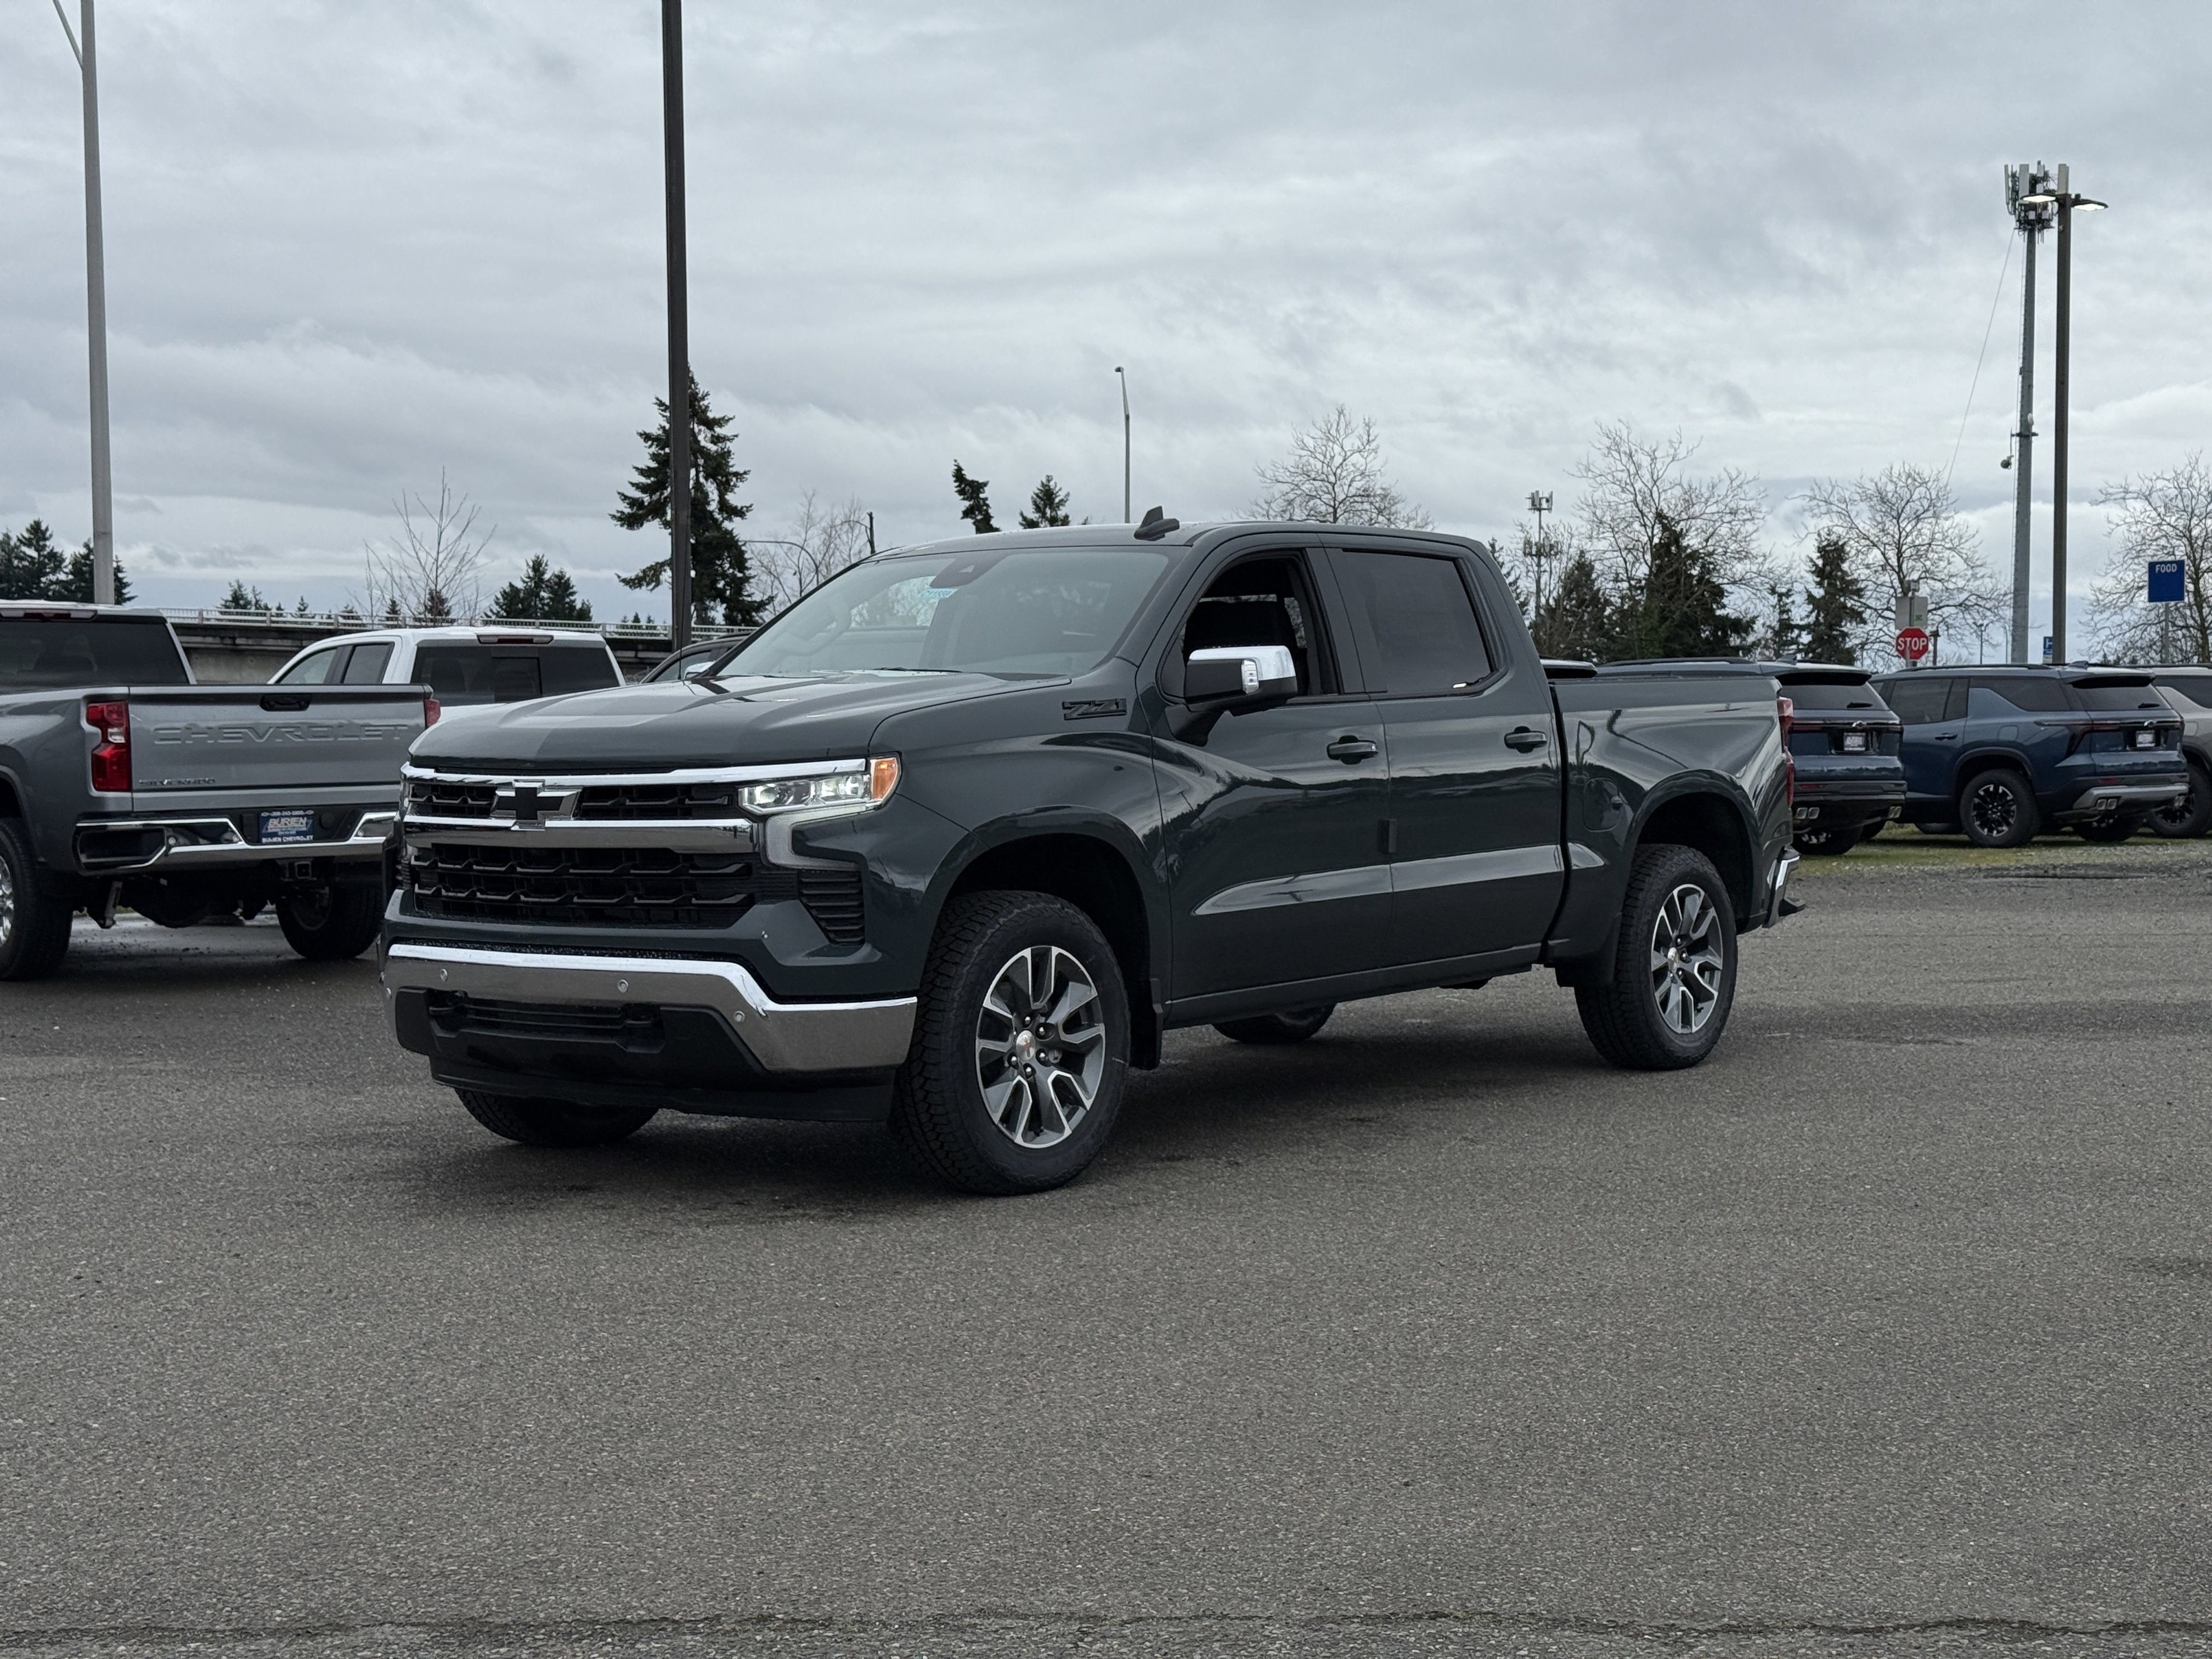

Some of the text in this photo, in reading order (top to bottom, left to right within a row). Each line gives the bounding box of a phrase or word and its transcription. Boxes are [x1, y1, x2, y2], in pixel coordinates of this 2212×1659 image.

[2155, 563, 2177, 573] FOOD
[1898, 637, 1927, 651] STOP
[154, 725, 408, 743] CHEVROLET
